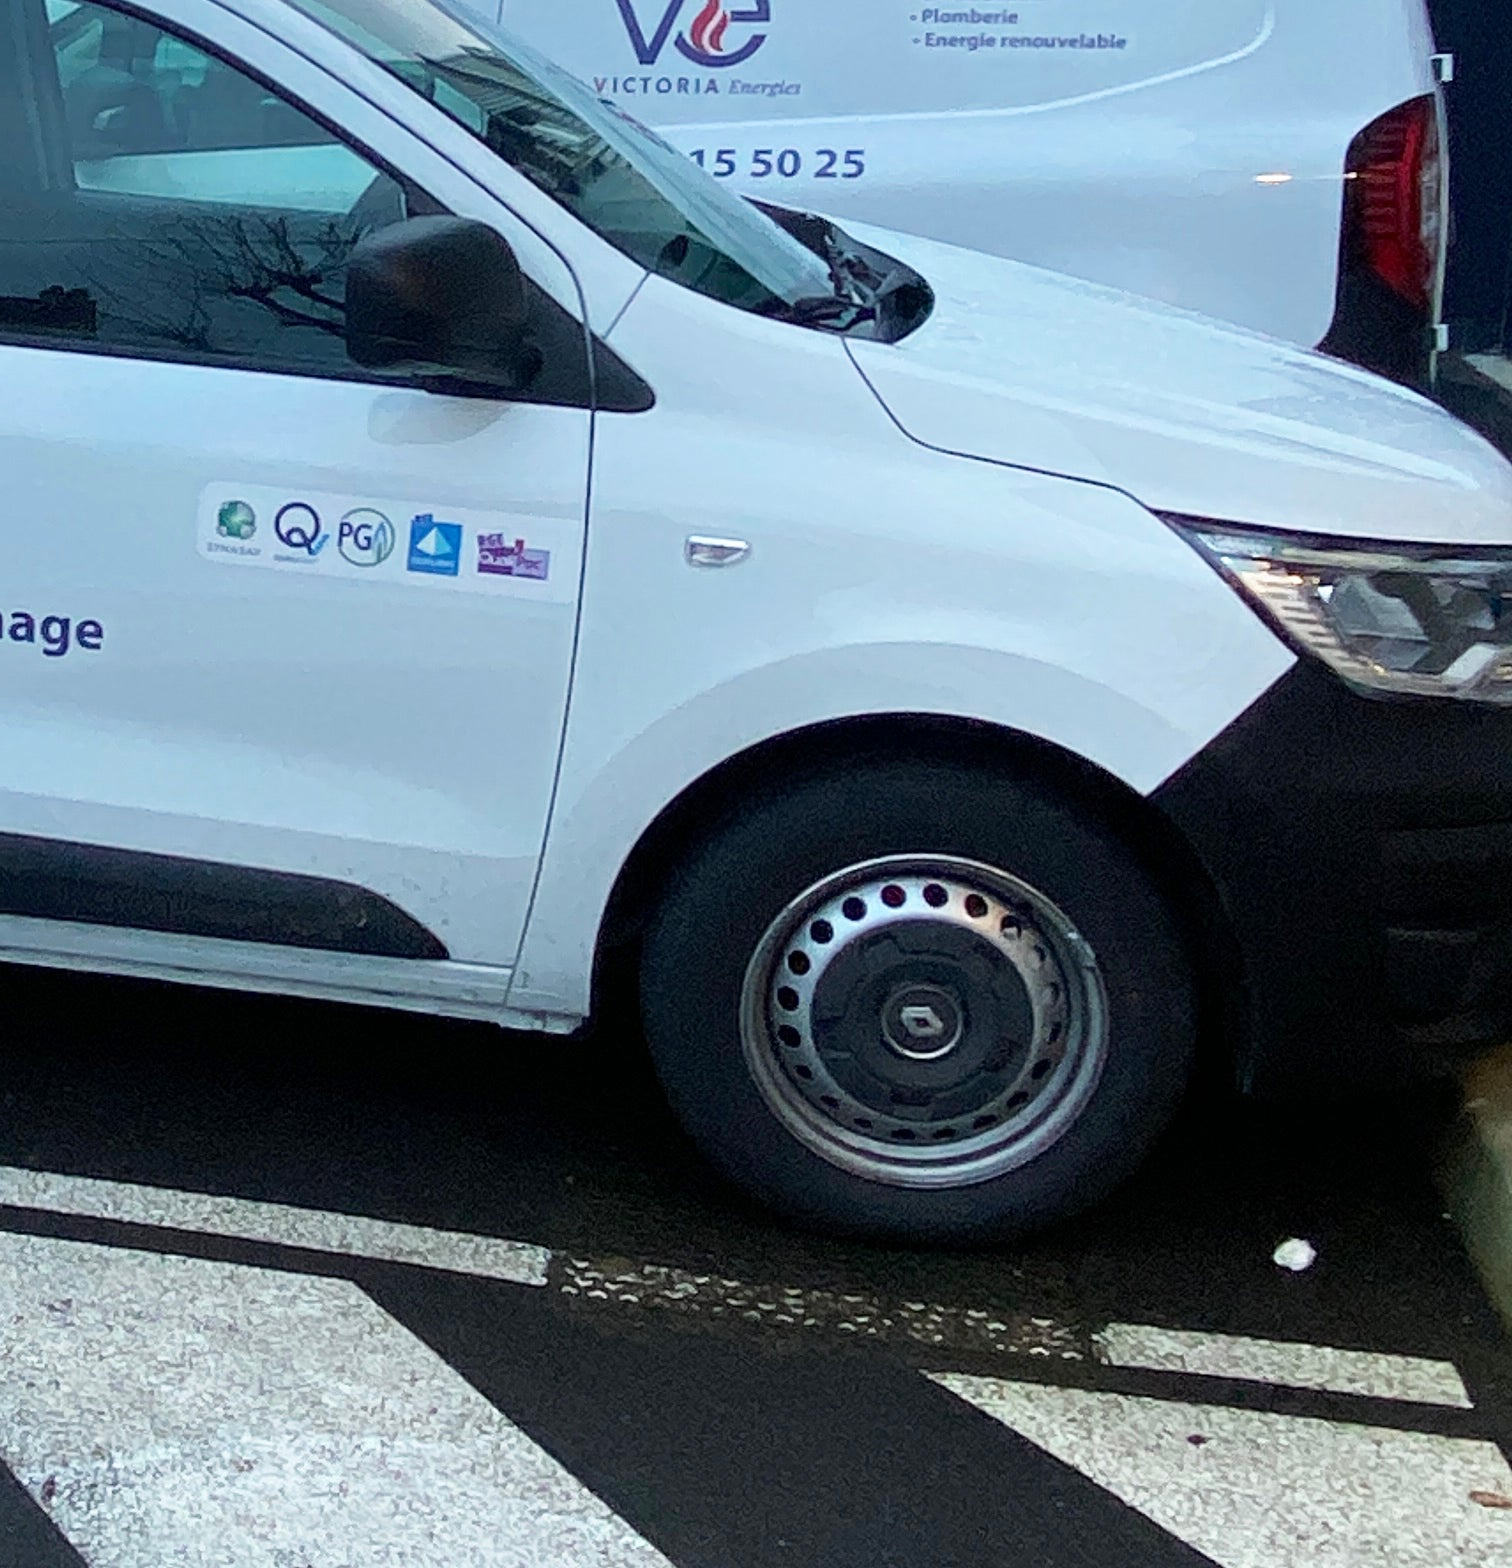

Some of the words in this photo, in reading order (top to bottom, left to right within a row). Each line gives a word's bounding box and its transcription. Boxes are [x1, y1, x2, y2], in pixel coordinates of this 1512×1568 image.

[921, 8, 1019, 24] Plomberie
[925, 33, 996, 51] Energie
[1000, 34, 1127, 49] renouvelable
[593, 77, 720, 94] VICTORIA
[728, 80, 802, 97] Energies
[690, 149, 737, 178] 15
[750, 149, 802, 178] 50
[813, 149, 866, 179] 25
